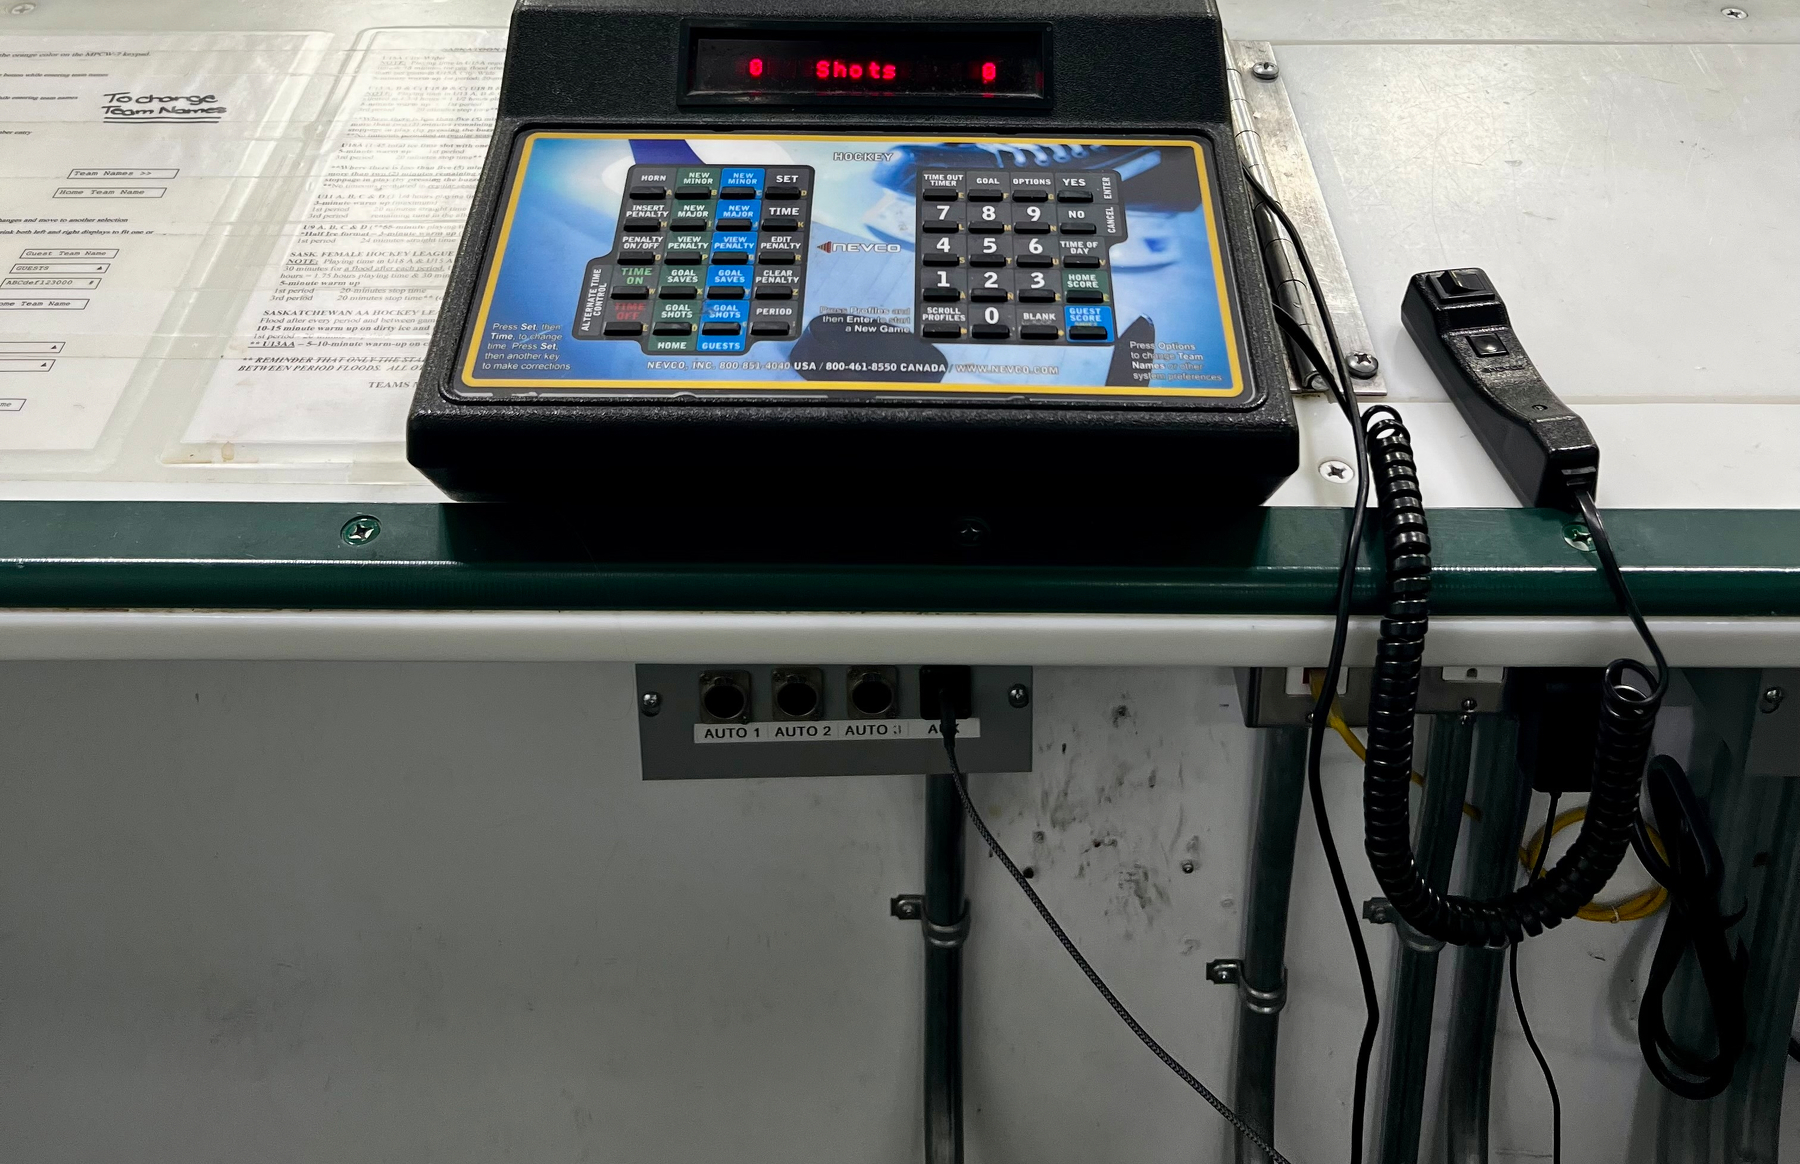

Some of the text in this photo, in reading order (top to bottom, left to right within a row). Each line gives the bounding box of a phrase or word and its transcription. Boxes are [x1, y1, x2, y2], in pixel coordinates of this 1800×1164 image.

[816, 60, 896, 80] Shots
[103, 92, 219, 105] To change
[101, 106, 228, 116] Team Names
[833, 152, 893, 161] HOCKEY
[776, 175, 799, 183] SET
[1062, 178, 1086, 186] YES
[1102, 177, 1112, 199] ENTER
[769, 207, 800, 216] TIME
[936, 205, 950, 218] 7
[982, 205, 996, 221] 8
[1026, 206, 1041, 222] 9
[1068, 210, 1085, 218] NO
[1105, 206, 1117, 234] CANCEL
[832, 243, 901, 252] NEVCO
[936, 237, 950, 253] 4
[983, 237, 997, 253] 5
[1028, 238, 1043, 254] 6
[1059, 240, 1083, 248] TIME
[621, 267, 652, 276] TIME
[626, 276, 644, 285] ON
[755, 276, 799, 284] PENALTY
[937, 271, 950, 287] 1
[983, 272, 998, 288] 2
[1030, 272, 1045, 288] 3
[581, 268, 602, 331] ALTERNATE TIME
[592, 282, 607, 316] CONTROL
[614, 302, 646, 311] TIME
[616, 312, 640, 321] OFF
[661, 311, 693, 319] SHOTS
[709, 311, 741, 319] SHOTS
[984, 306, 999, 324] 0
[1023, 312, 1056, 320] BLANK
[1069, 314, 1101, 322] SCORE
[702, 342, 741, 350] GUESTS
[544, 353, 560, 362] key
[493, 362, 519, 370] make
[647, 361, 1059, 374] NEVCO, INC. 800-851-4040 USA 800-461-8550 CANADA WWW.NEVCO.COM
[704, 727, 748, 739] AUTO
[754, 728, 761, 738] 1
[774, 726, 818, 738] AUTO
[823, 726, 831, 737] 2
[845, 724, 888, 736] AUTO
